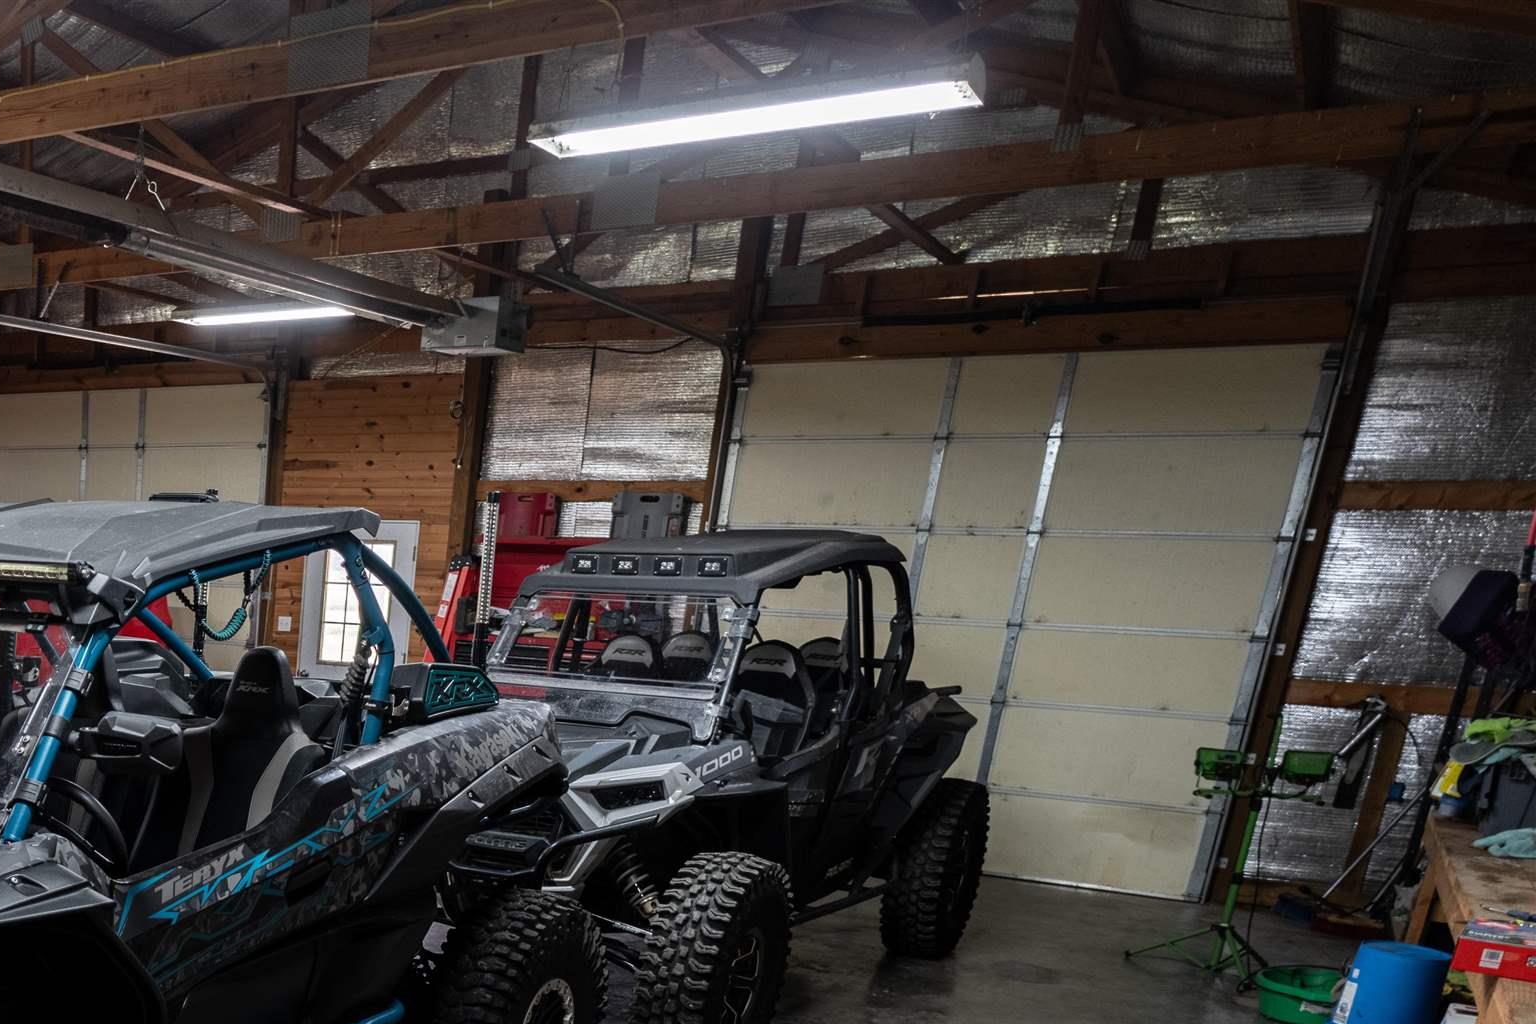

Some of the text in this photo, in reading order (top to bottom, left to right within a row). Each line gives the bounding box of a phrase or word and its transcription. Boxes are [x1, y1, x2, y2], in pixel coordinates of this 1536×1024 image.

[613, 646, 645, 656] RZR
[749, 657, 786, 667] RZR
[695, 745, 743, 778] 1000
[154, 842, 253, 905] TERYX
